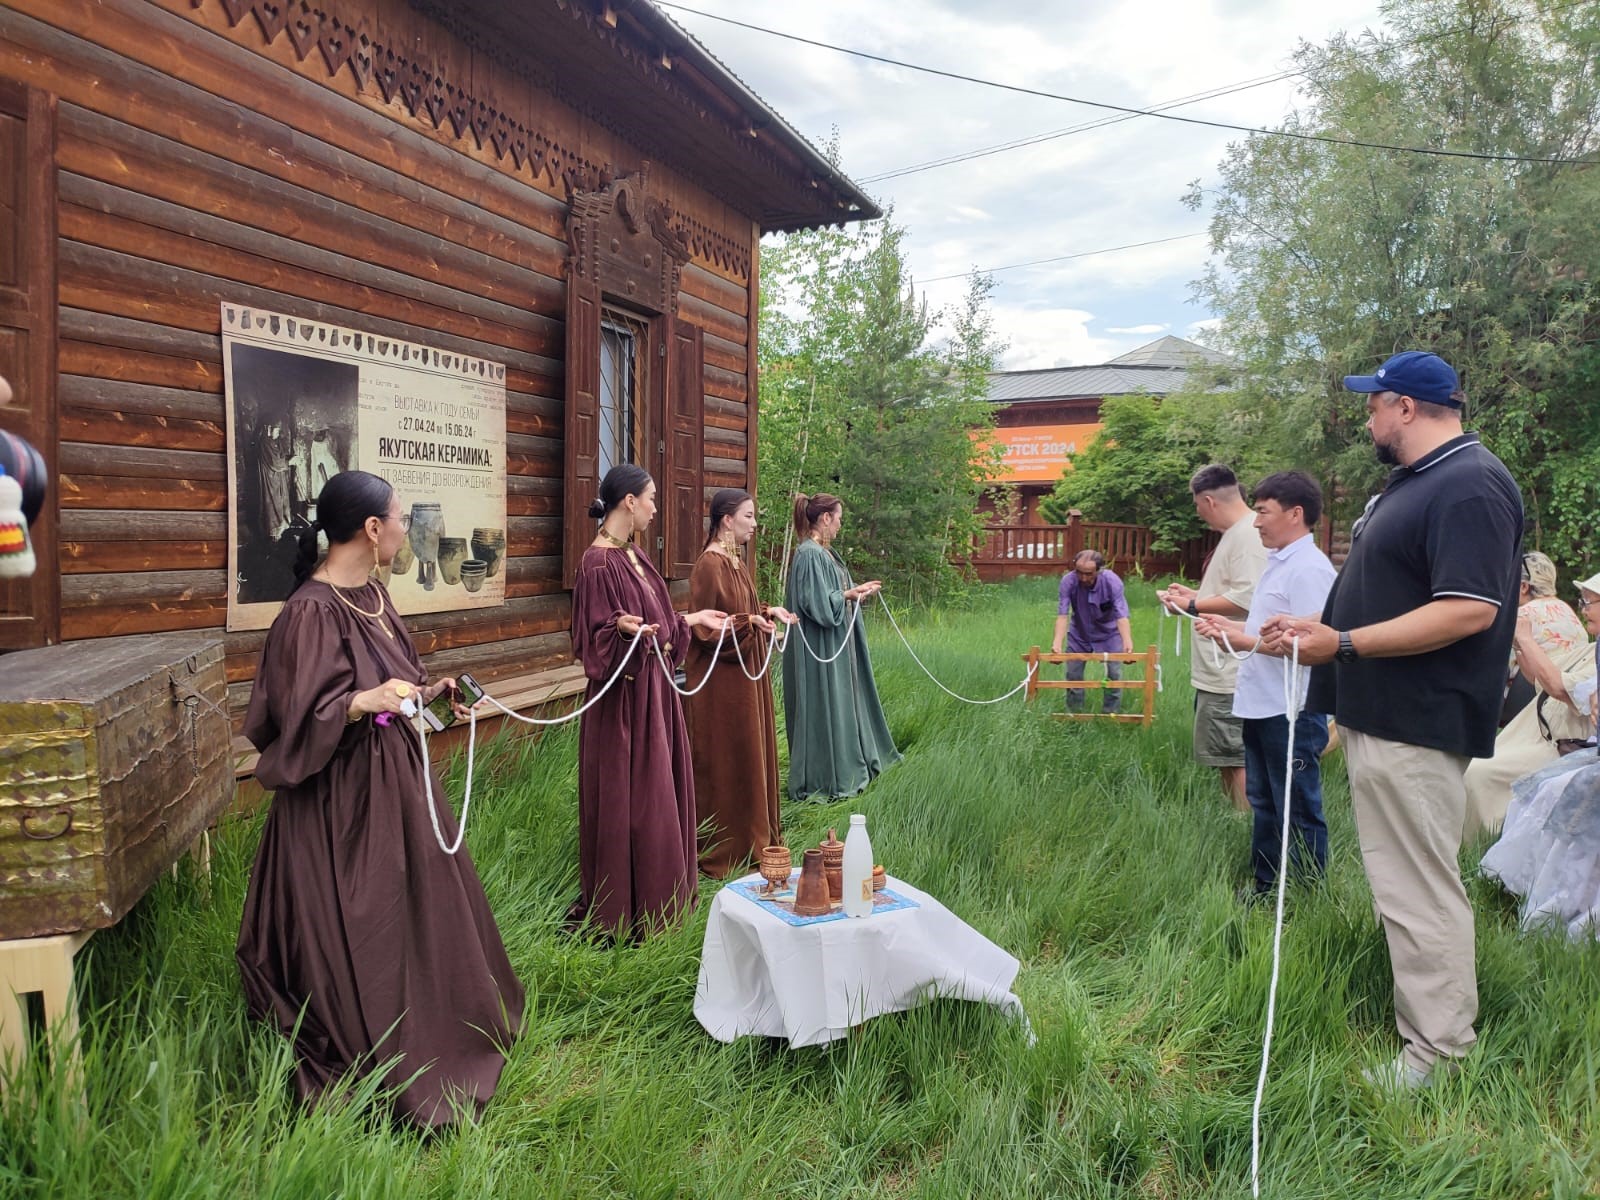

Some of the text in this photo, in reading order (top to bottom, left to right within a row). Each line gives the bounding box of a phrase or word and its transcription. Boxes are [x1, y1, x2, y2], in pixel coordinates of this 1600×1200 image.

[394, 394, 433, 413] ВЫСТАВКА
[434, 401, 438, 413] К
[440, 402, 458, 419] ГОДУ
[459, 406, 480, 422] СЕМЬИ
[403, 417, 435, 433] 27.04.24
[445, 423, 473, 438] 15.06.24
[379, 437, 493, 467] ЯКУТСКАЯ КЕРАМИКА:
[1041, 441, 1075, 455] 2024
[392, 470, 431, 485] ЗАБВЕНИЯ
[432, 474, 442, 487] ДО
[443, 474, 492, 489] ВОЗРОЖДЕНИЯ
